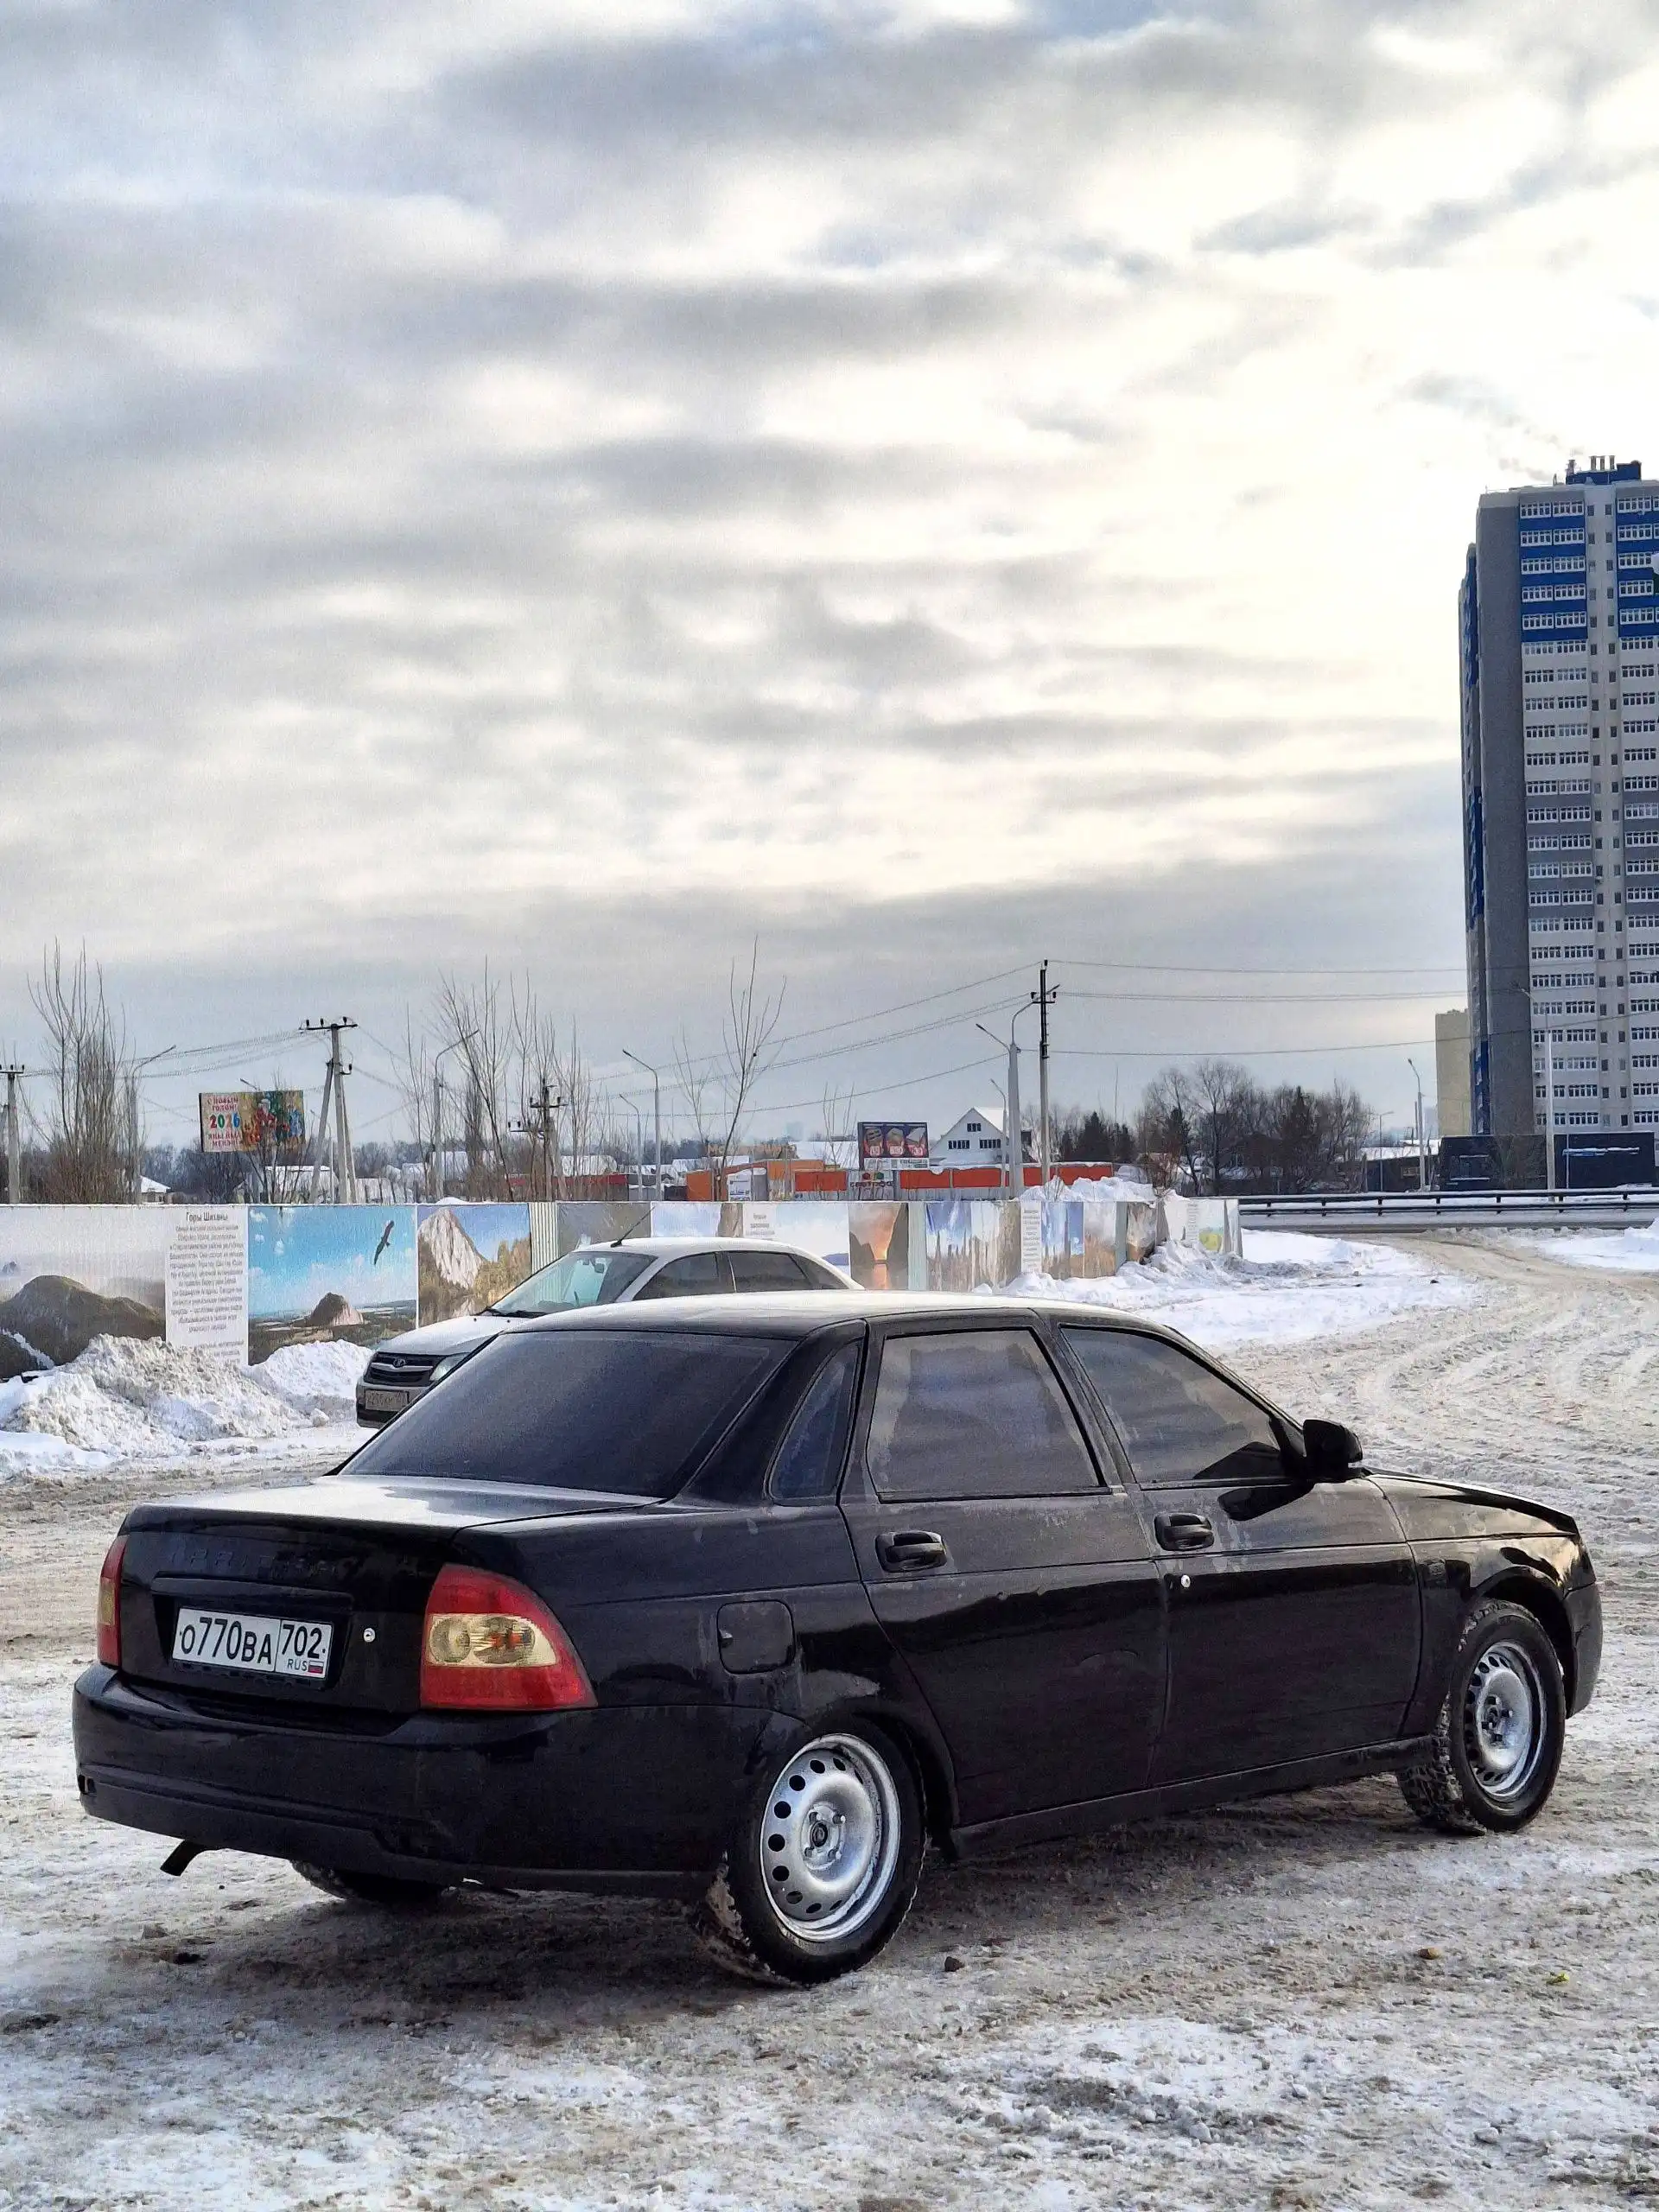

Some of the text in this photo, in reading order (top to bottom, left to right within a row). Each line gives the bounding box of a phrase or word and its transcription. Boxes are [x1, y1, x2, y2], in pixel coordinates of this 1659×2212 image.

[187, 1211, 201, 1224] Горы
[281, 1624, 323, 1659] 702
[287, 1658, 308, 1672] RUS
